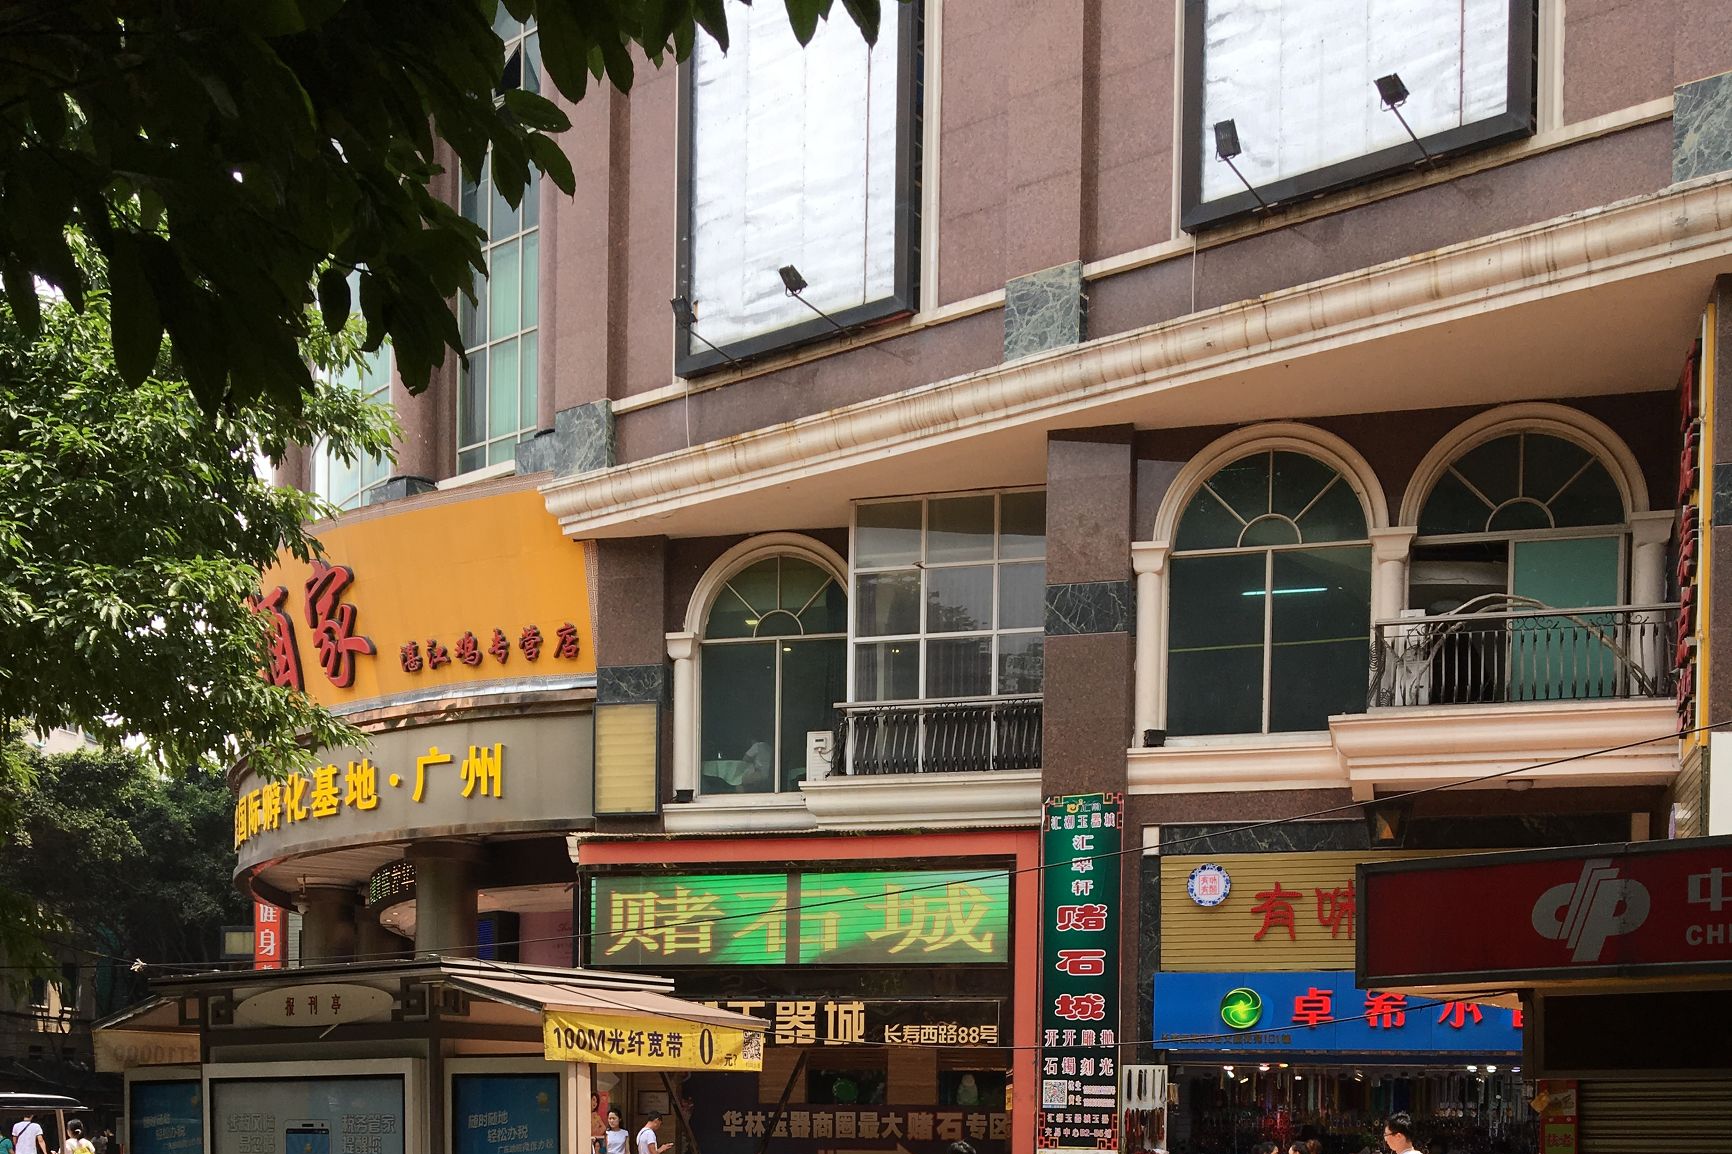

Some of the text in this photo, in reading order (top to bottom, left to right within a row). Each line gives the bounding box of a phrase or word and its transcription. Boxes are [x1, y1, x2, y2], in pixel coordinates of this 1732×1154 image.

[400, 622, 580, 672] 湛江鸡专营店
[235, 743, 503, 852] 国际孵化基地·广州
[259, 904, 277, 970] 健身
[604, 882, 998, 955] 赌石城
[1056, 904, 1107, 1020] 赌石城
[285, 994, 341, 1016] 报刊亭
[1292, 987, 1523, 1028] 卓希水
[553, 1027, 683, 1059] 100M光纤宽带
[699, 1028, 714, 1065] 0
[884, 1024, 998, 1044] 长寿西路88号
